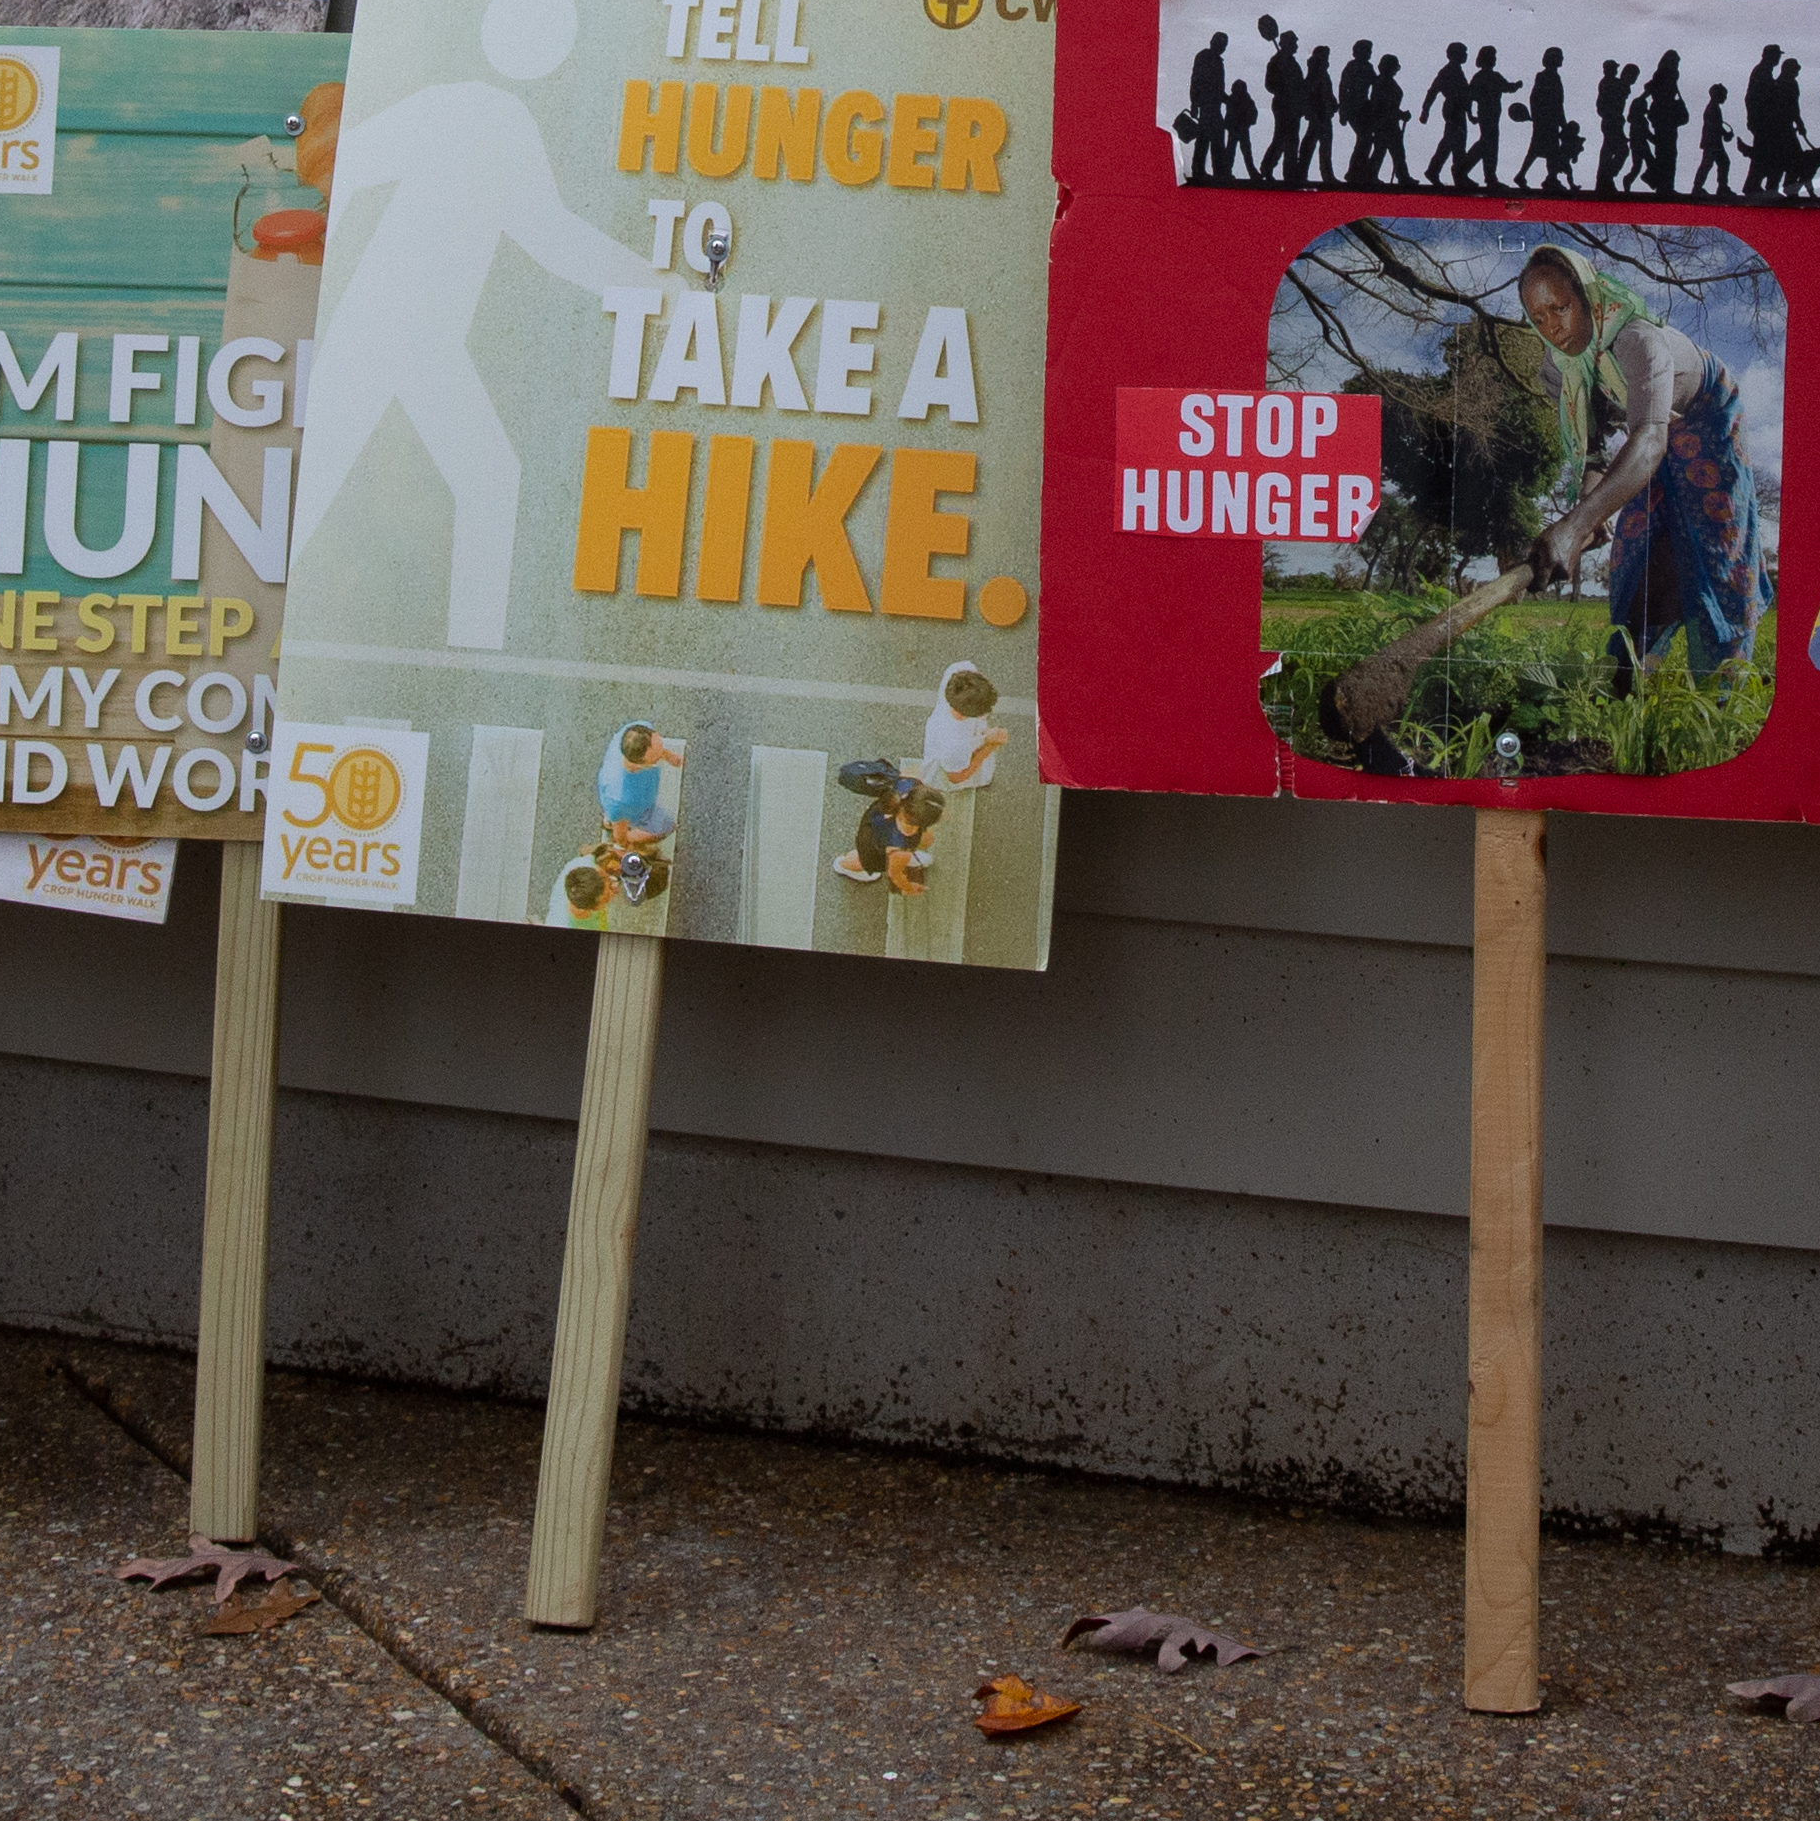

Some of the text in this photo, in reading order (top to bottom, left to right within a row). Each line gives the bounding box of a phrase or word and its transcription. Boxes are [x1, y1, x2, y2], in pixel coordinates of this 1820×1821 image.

[616, 79, 1008, 194] HUNGER
[12, 173, 38, 183] WALK
[647, 198, 733, 275] TO
[601, 285, 980, 424] TAKE A
[1179, 393, 1338, 459] STOP
[572, 424, 1029, 629] HIKE.
[1121, 467, 1375, 539] HUNGER
[74, 592, 255, 658] STEP
[282, 740, 402, 832] 50
[25, 842, 164, 896] years
[279, 832, 401, 880] years
[295, 871, 400, 891] CROP HUNGER WALK
[41, 883, 159, 910] CROP HUNGER WALK
